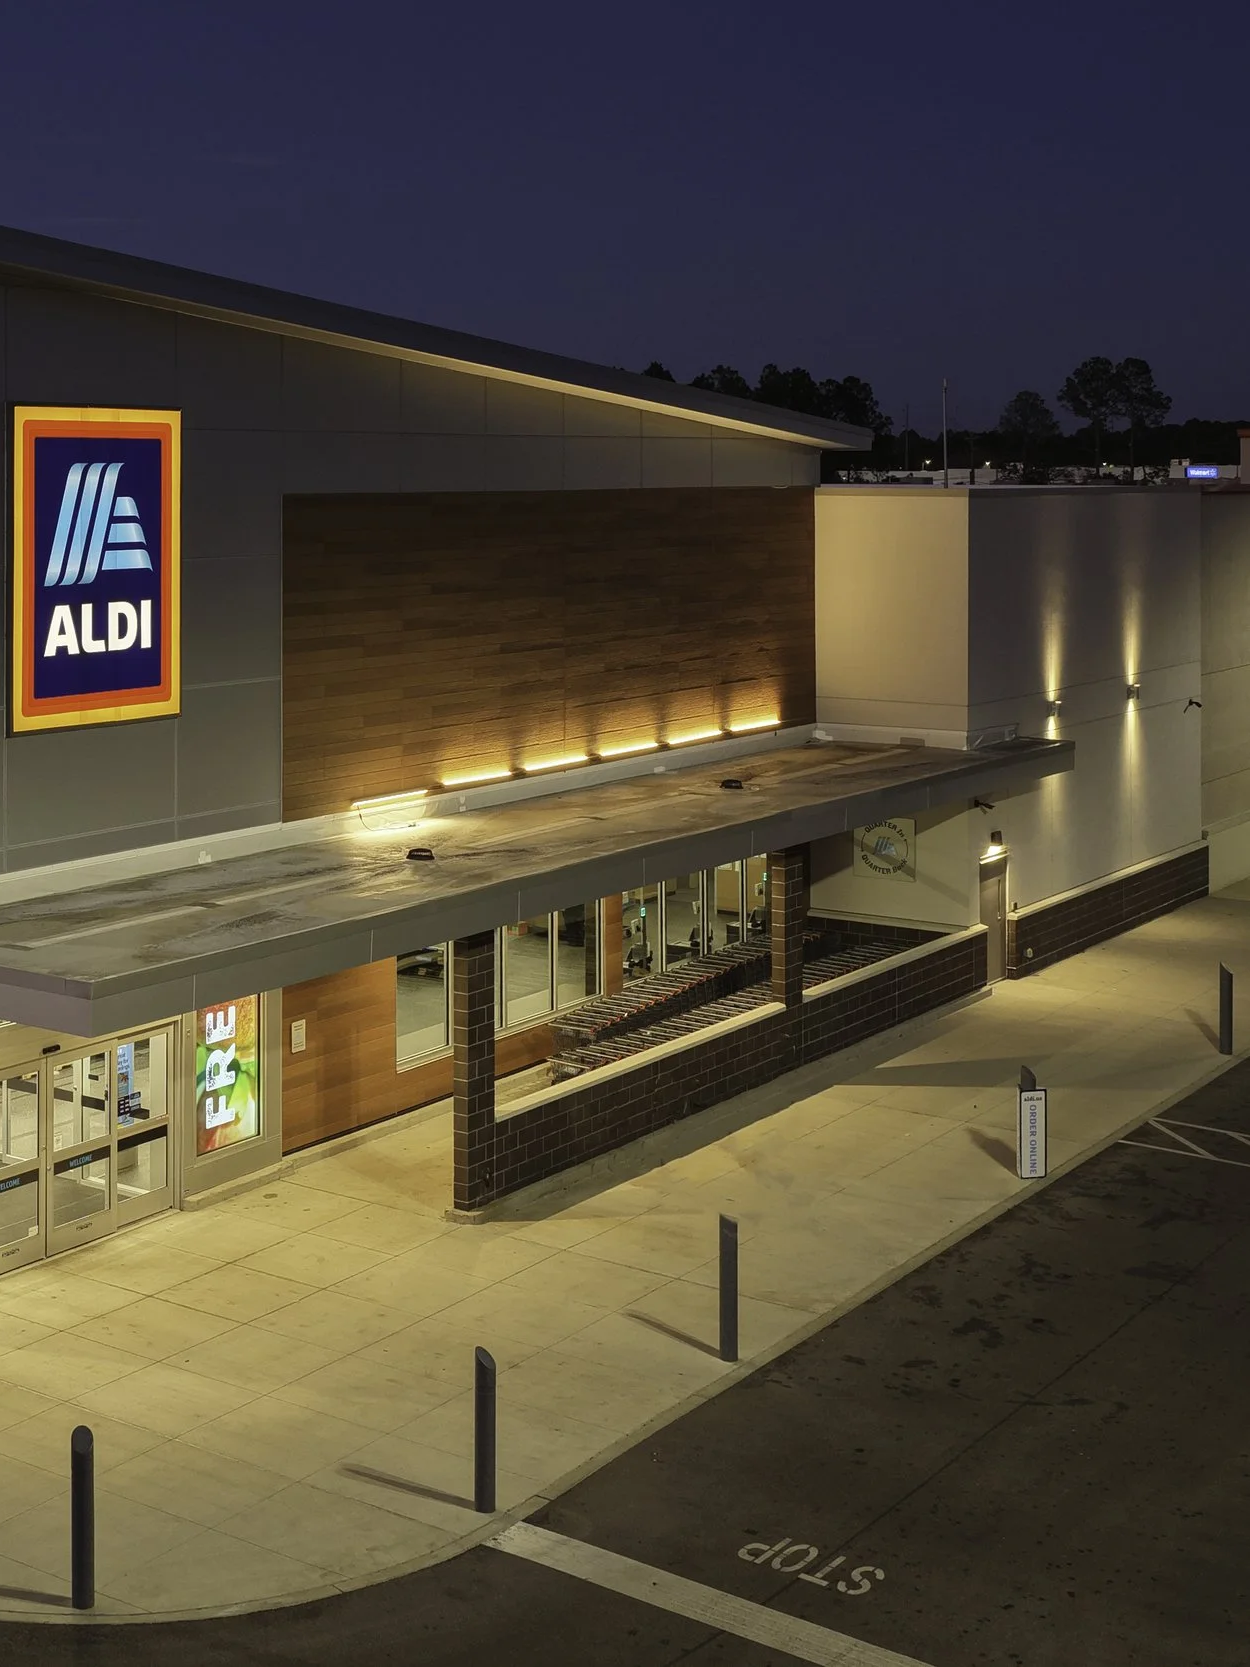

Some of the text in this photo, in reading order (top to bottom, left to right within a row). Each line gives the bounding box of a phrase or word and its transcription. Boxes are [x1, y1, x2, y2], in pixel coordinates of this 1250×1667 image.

[43, 599, 152, 657] ALDI
[861, 854, 892, 874] QUARTER
[69, 1154, 93, 1167] WELCOME
[1029, 1104, 1037, 1175] ORDER ONLINE
[737, 1537, 885, 1595] STOP
